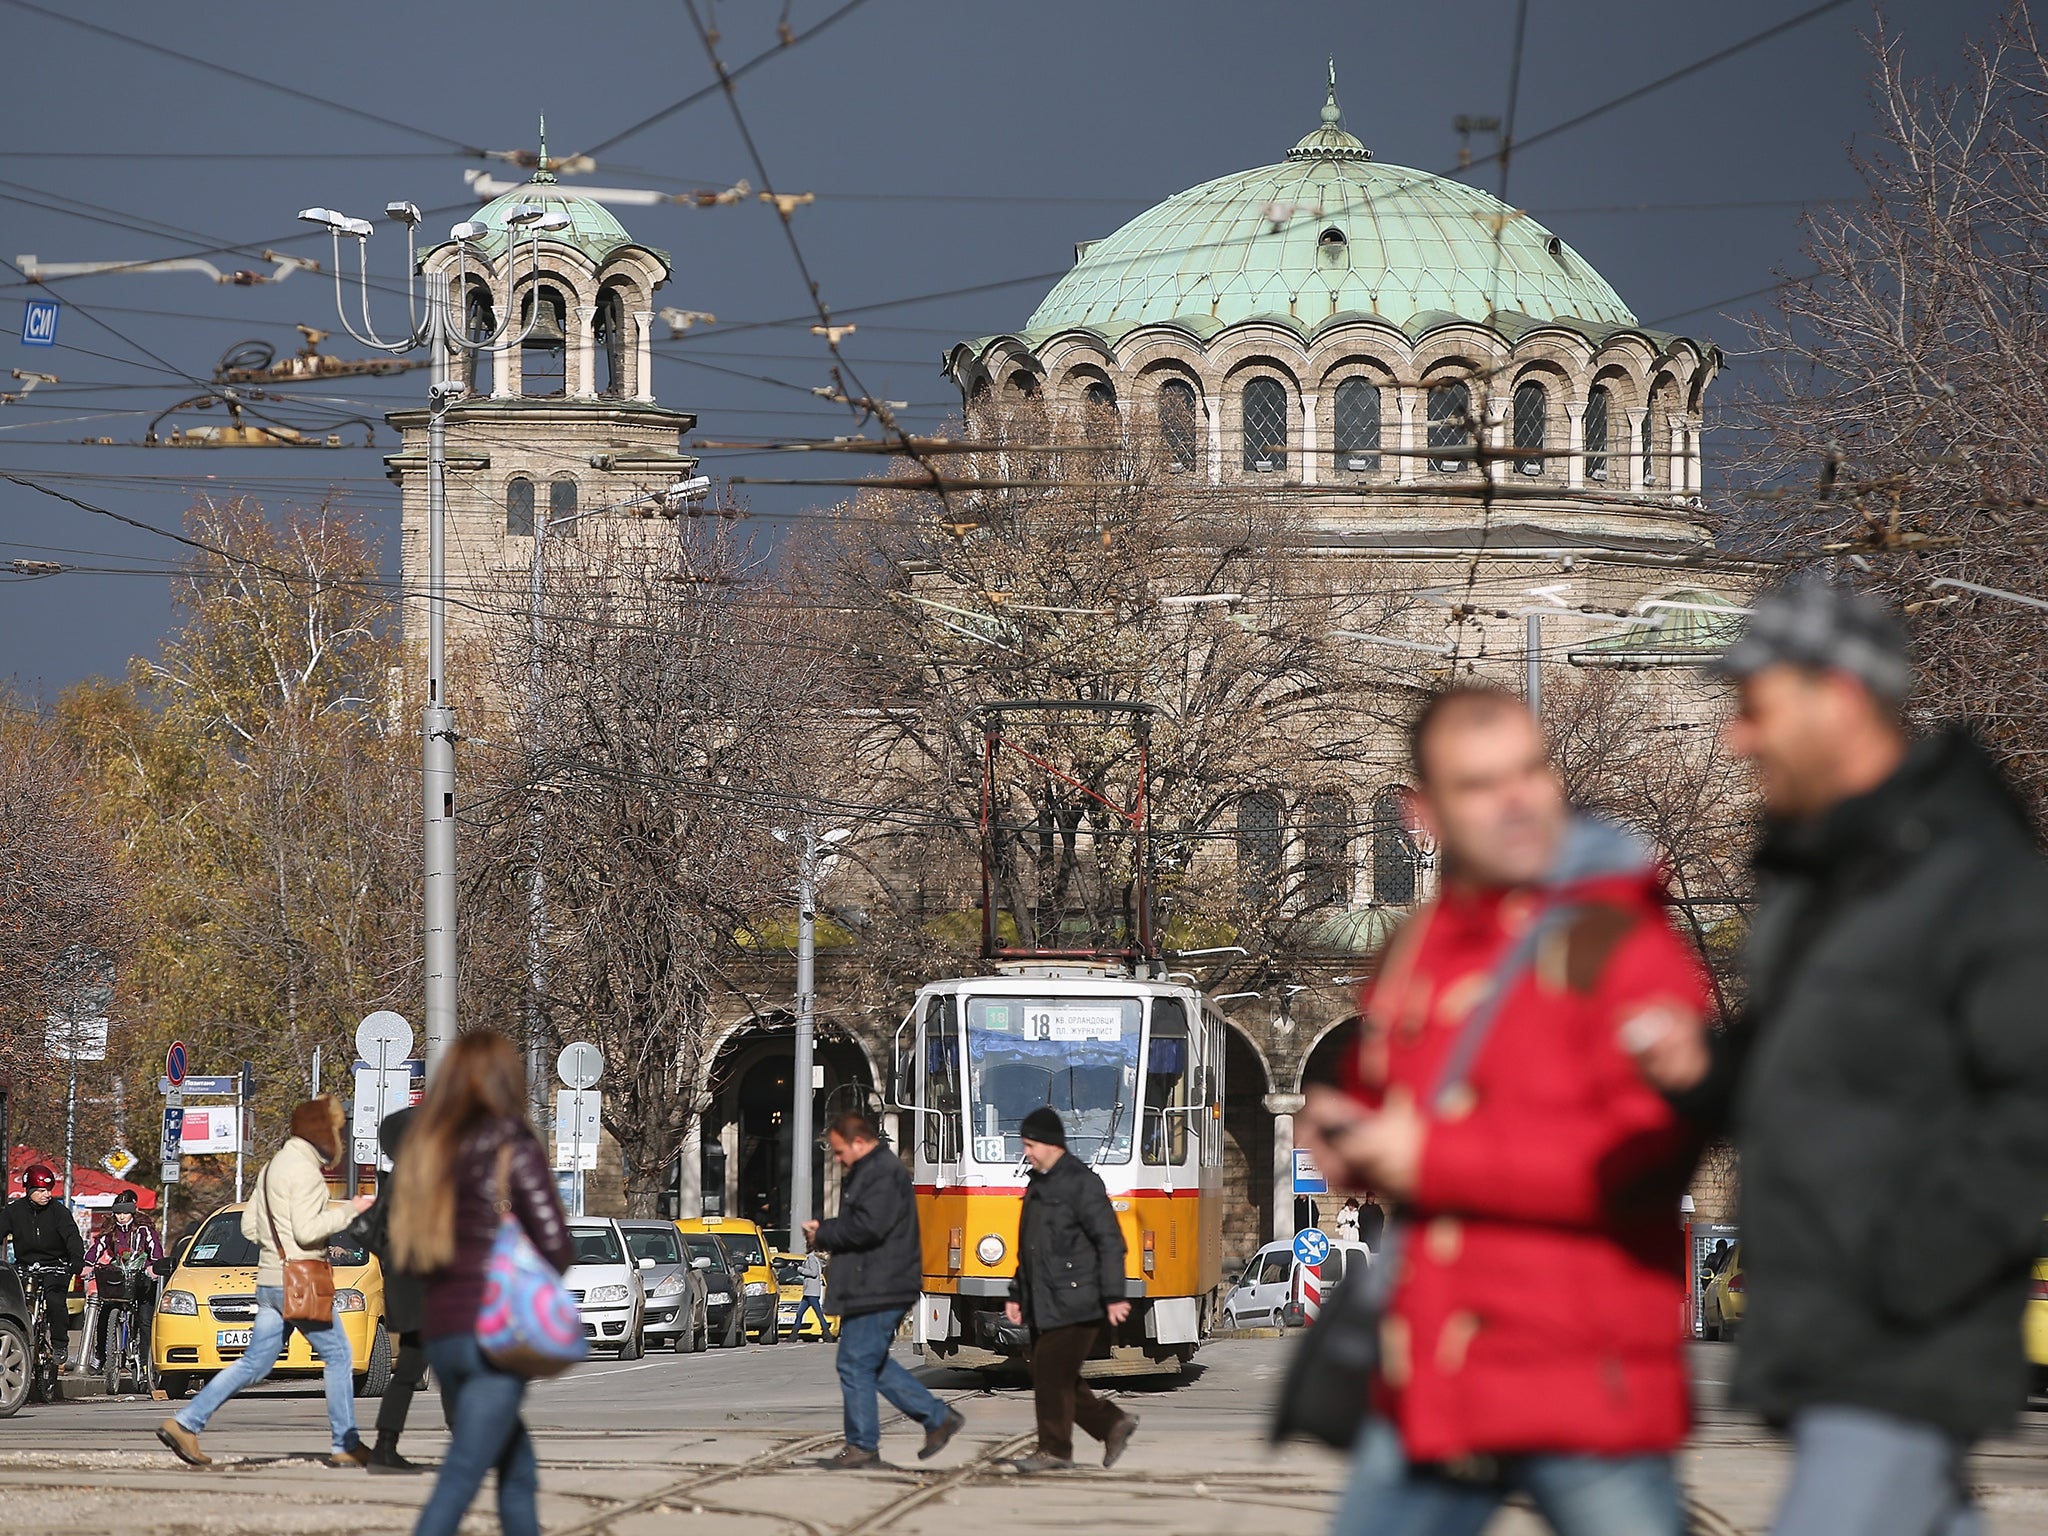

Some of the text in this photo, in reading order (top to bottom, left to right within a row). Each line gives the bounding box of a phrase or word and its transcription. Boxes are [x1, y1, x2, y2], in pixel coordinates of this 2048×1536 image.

[30, 307, 53, 336] СИ
[990, 1012, 1006, 1024] 18
[1031, 1013, 1050, 1036] 18
[976, 1140, 1001, 1161] 18
[224, 1333, 240, 1344] CA
